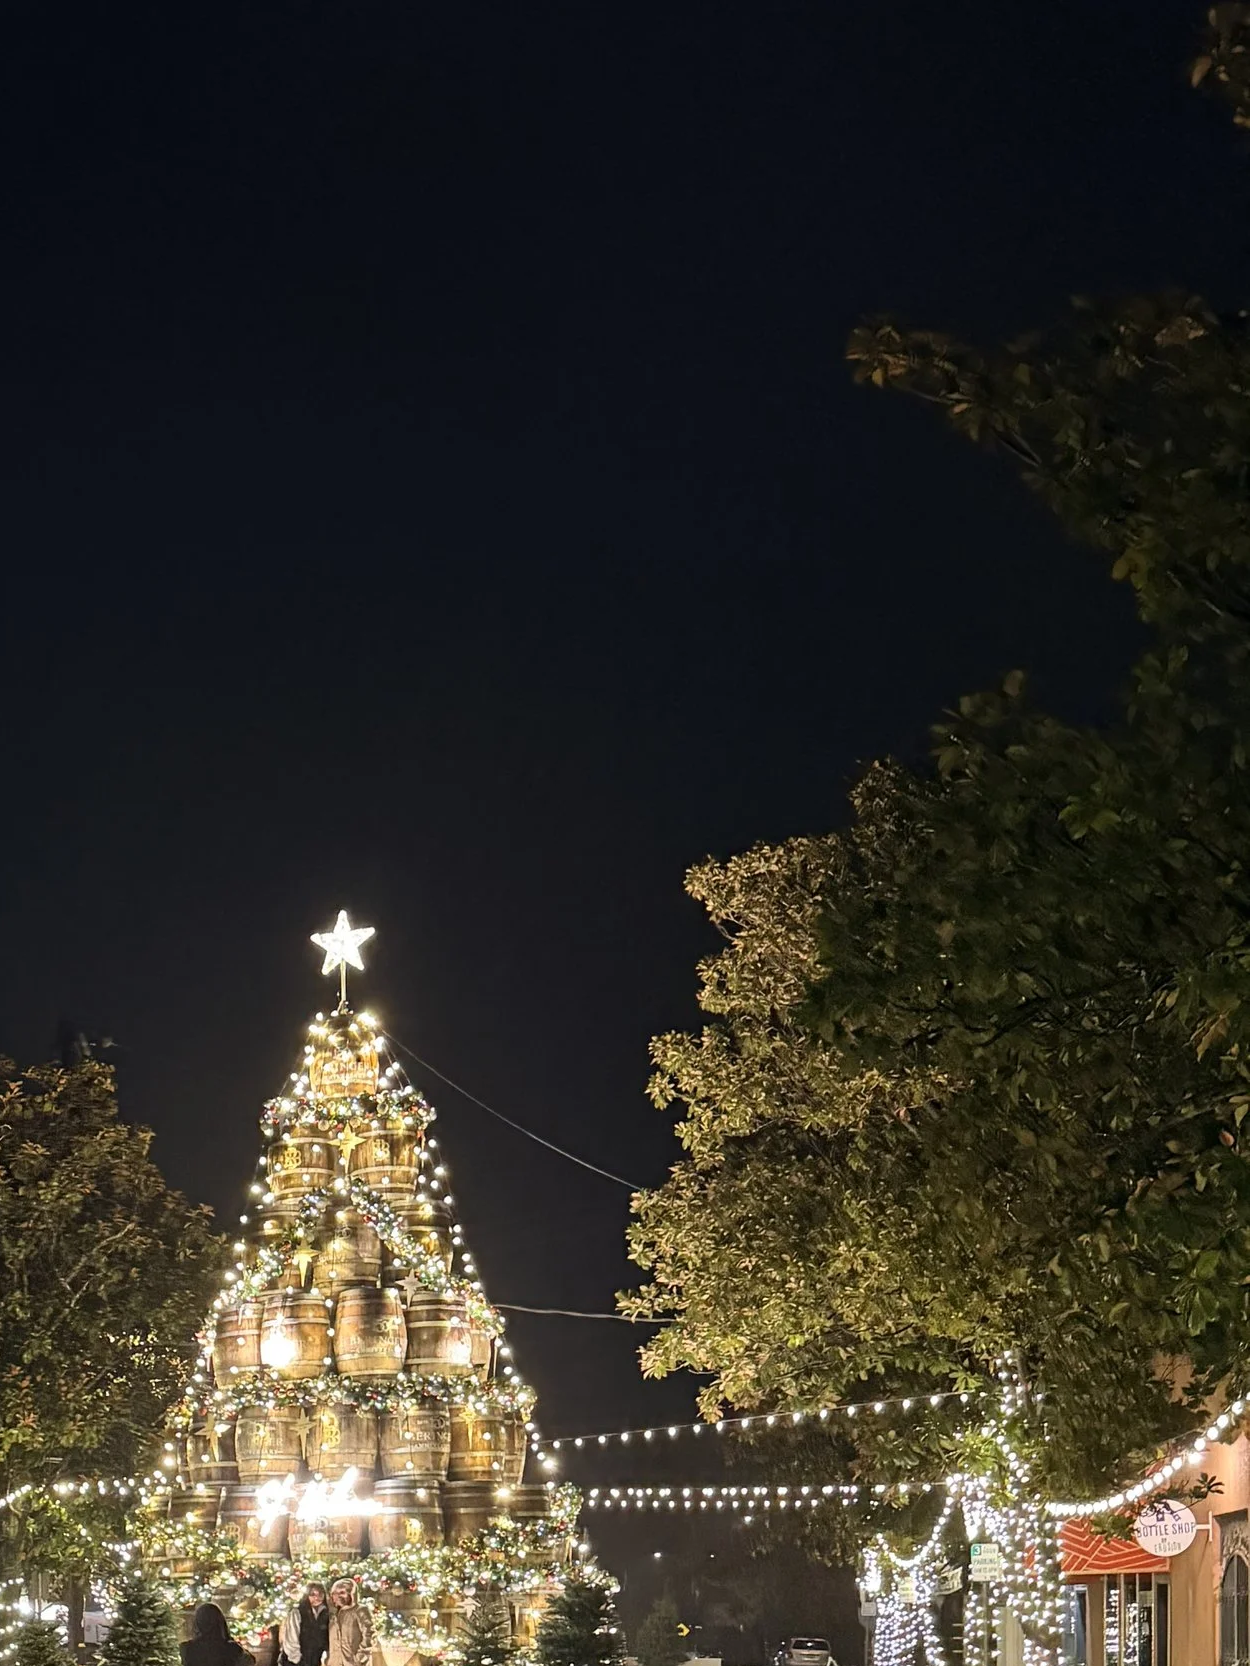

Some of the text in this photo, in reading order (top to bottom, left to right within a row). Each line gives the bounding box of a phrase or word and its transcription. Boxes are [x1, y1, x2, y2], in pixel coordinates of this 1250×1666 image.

[1136, 1521, 1196, 1538] BOTTLE SHOP
[974, 1546, 981, 1555] 3
